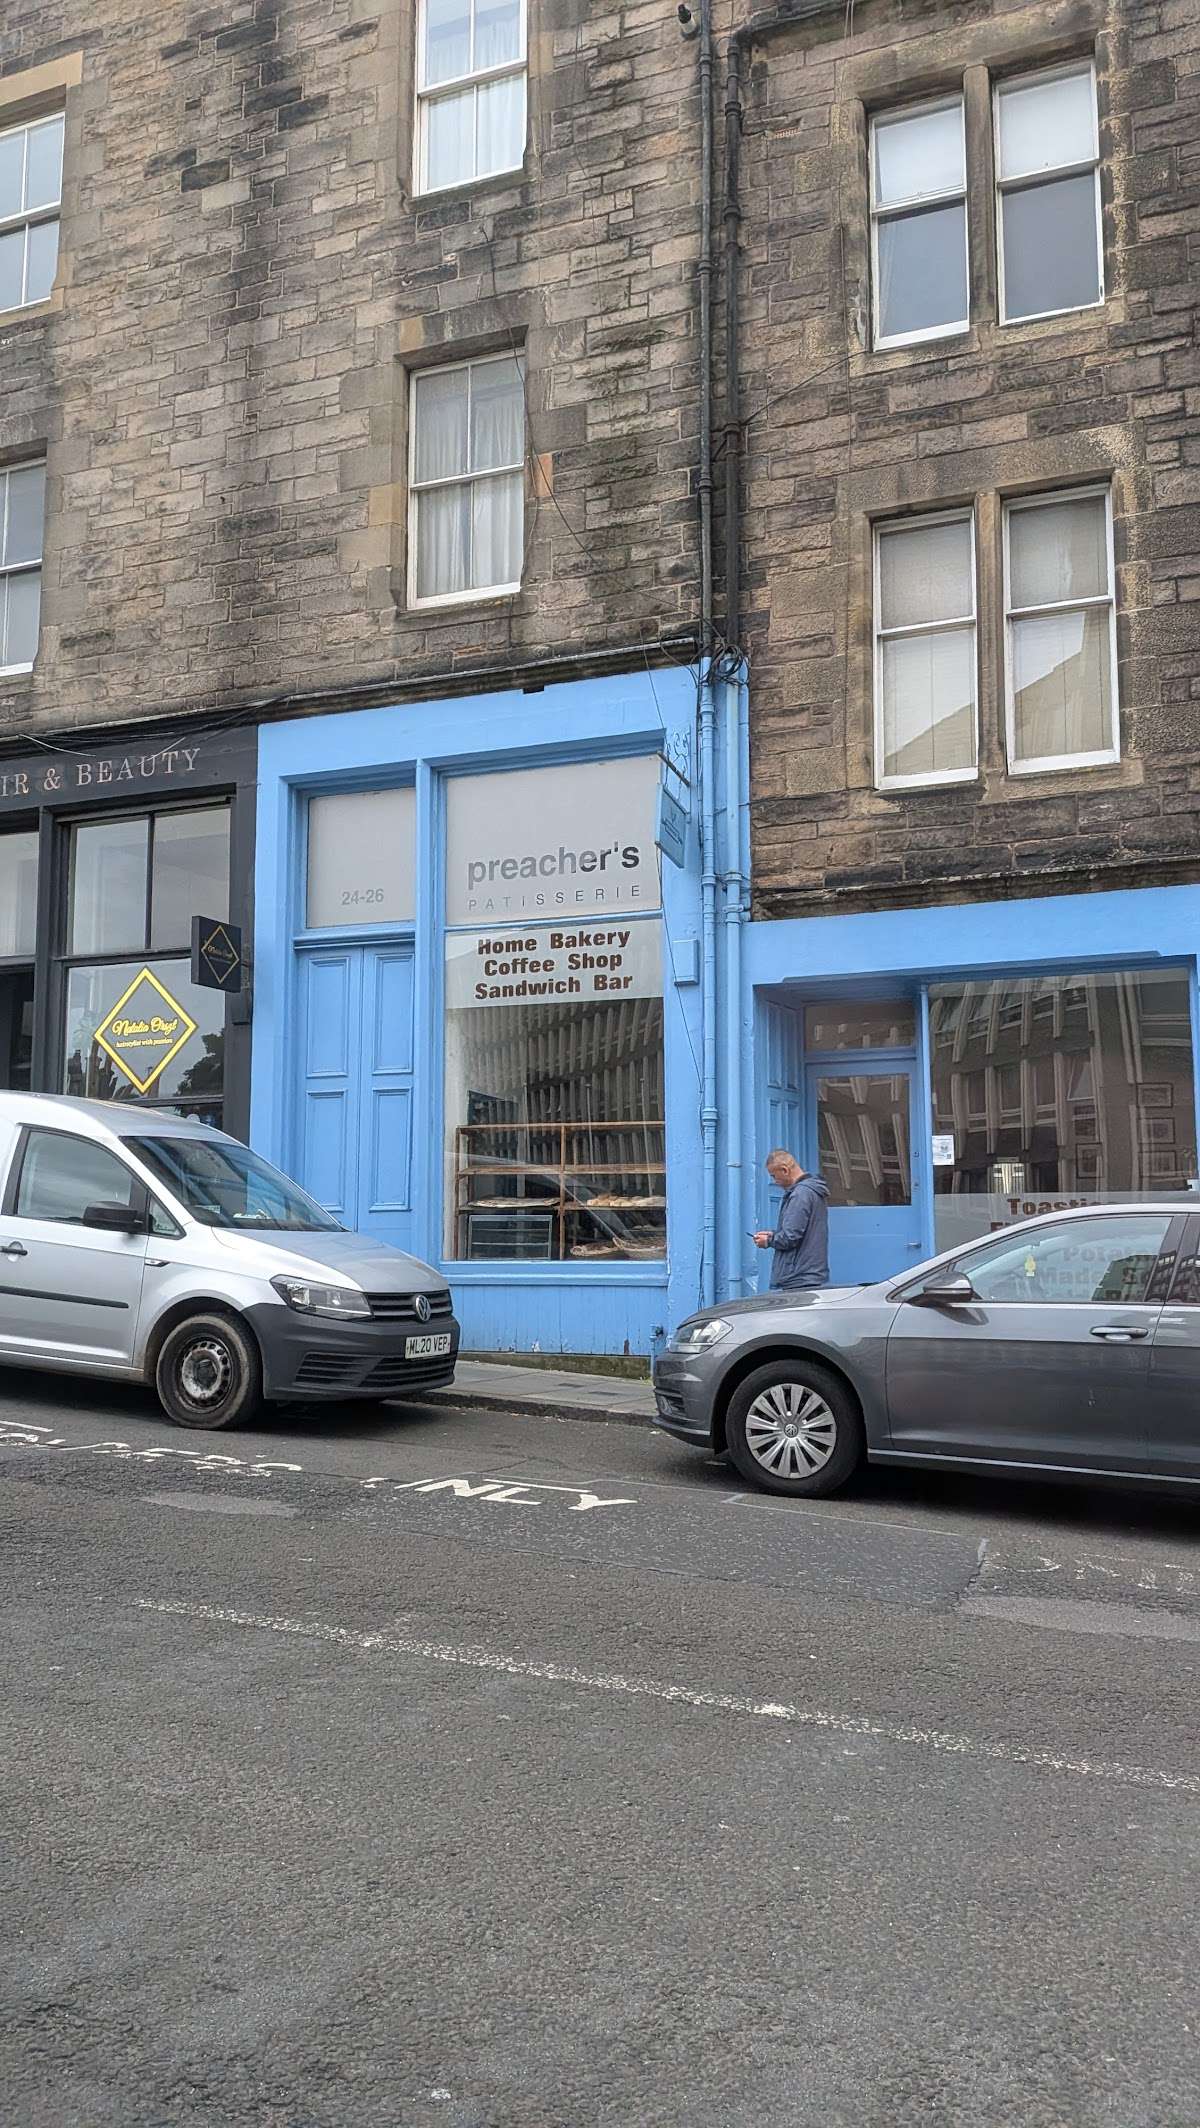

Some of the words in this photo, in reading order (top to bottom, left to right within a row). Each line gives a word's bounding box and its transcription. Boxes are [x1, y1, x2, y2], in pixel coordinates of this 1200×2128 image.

[43, 768, 61, 791] &
[76, 748, 200, 786] BEAUTY
[467, 841, 640, 890] preacher's
[341, 888, 385, 907] 24-26
[468, 884, 641, 911] PATISSERIE
[477, 934, 538, 955] Home
[550, 930, 631, 950] Bakery
[484, 956, 555, 977] Coffee
[567, 952, 623, 973] Shop
[475, 976, 581, 1000] Sandwich
[593, 972, 634, 992] Bar
